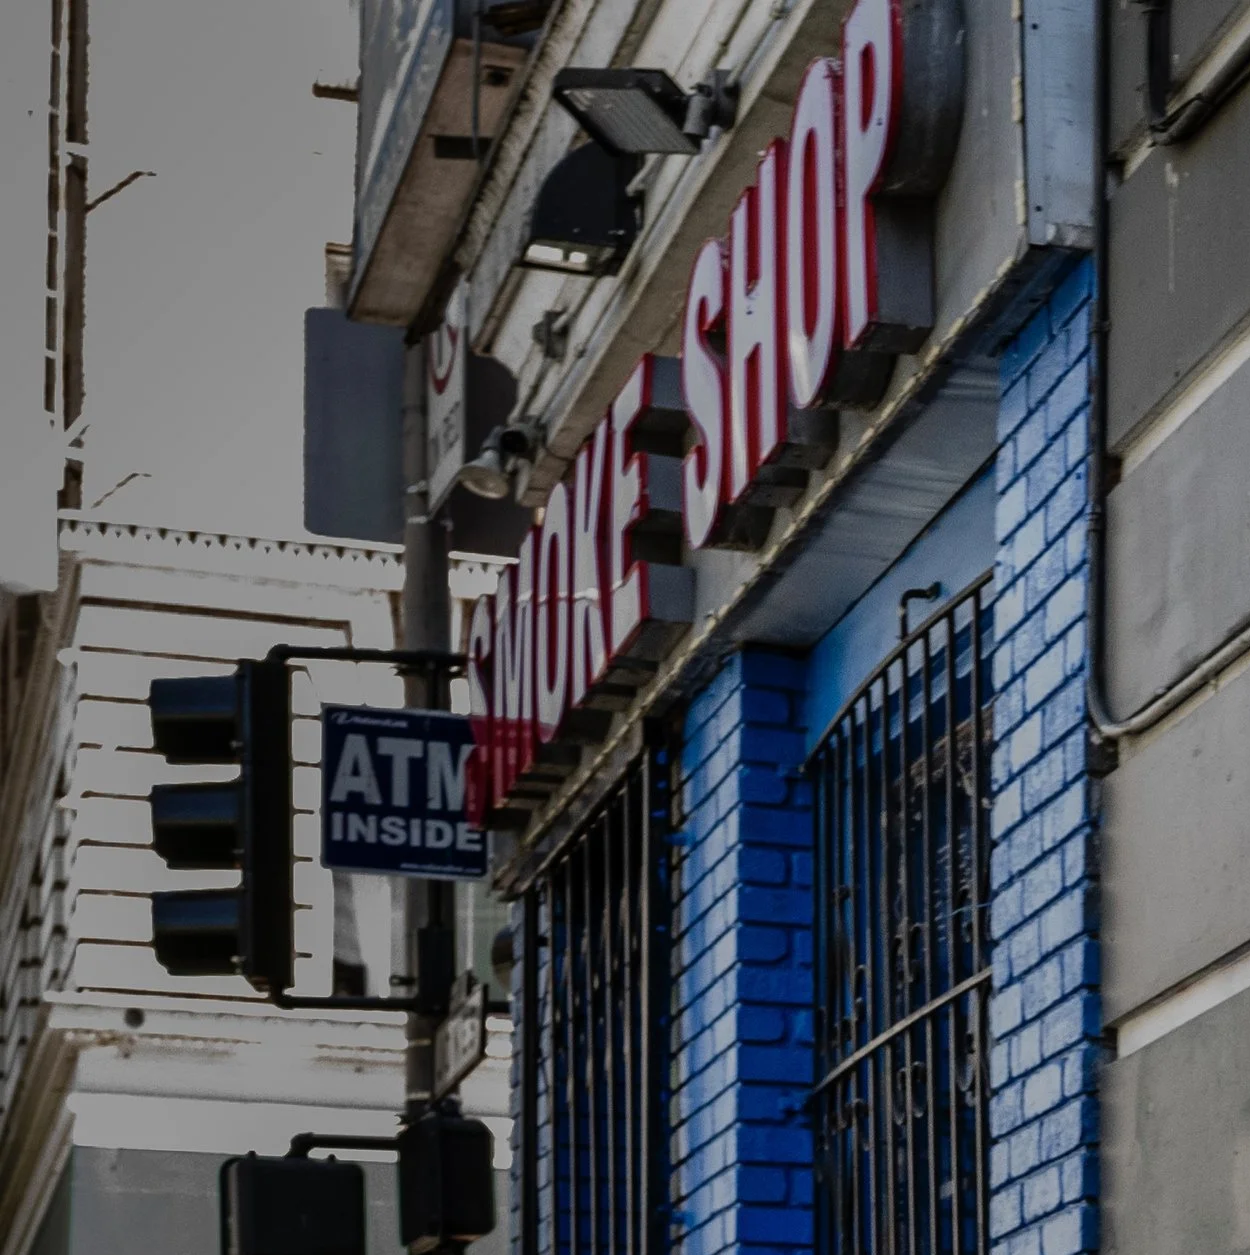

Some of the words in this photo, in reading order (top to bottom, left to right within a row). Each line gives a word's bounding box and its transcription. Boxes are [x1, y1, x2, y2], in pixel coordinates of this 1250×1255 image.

[467, 353, 648, 830] SMOKE
[683, 0, 902, 549] SHOP
[330, 733, 477, 811] ATM
[331, 811, 483, 852] INSIDE
